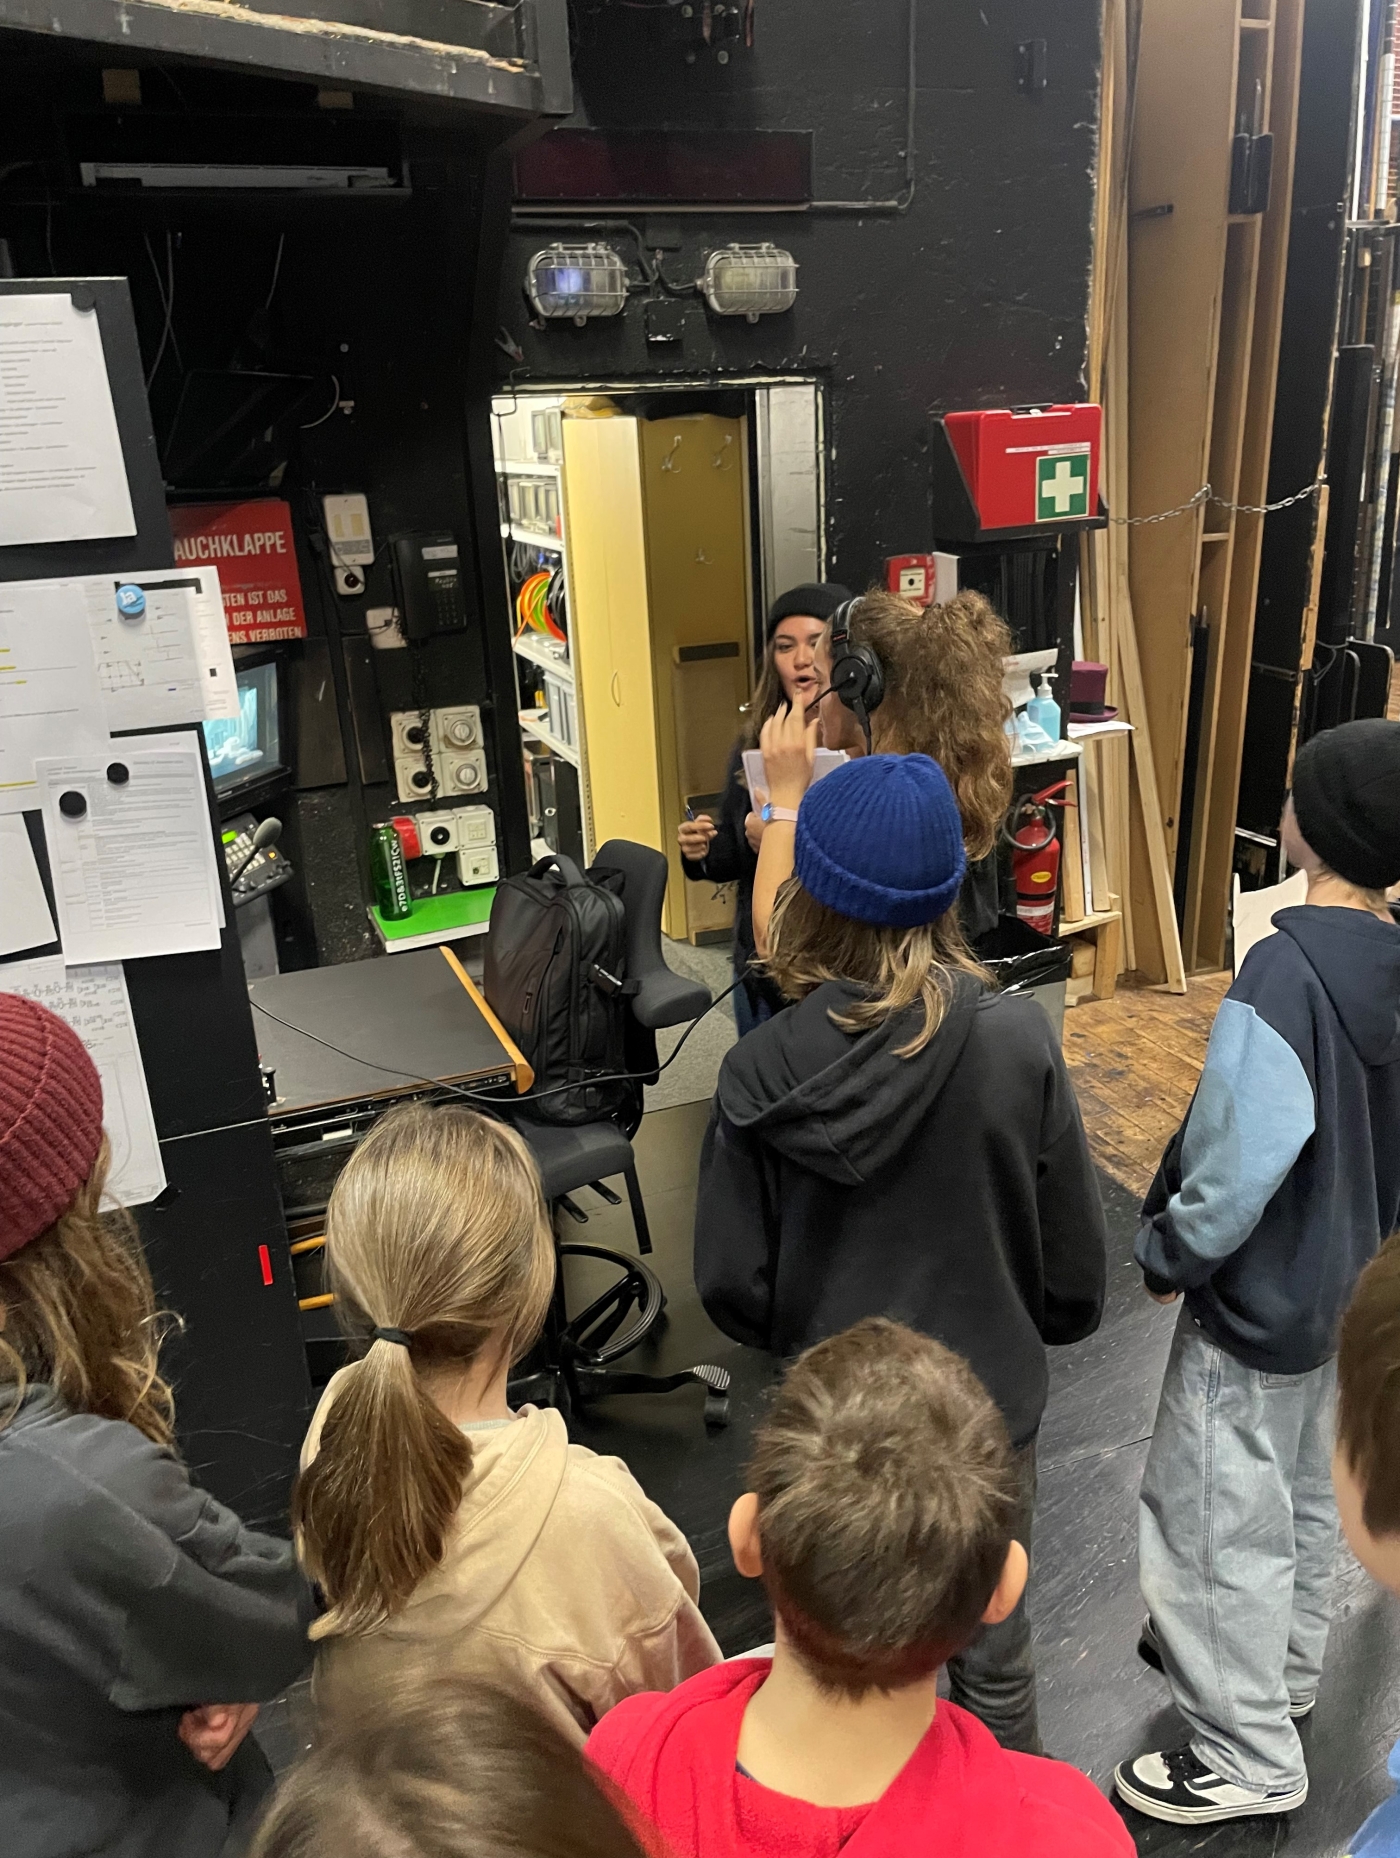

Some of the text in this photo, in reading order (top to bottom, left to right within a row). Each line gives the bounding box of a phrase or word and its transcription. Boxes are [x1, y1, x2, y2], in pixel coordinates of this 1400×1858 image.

[174, 531, 286, 561] AUCHKLAPPE
[247, 591, 264, 605] IST
[267, 589, 288, 603] DAS
[232, 611, 254, 626] DER
[256, 607, 296, 624] ANLAGE
[249, 626, 302, 642] VERBOTEN
